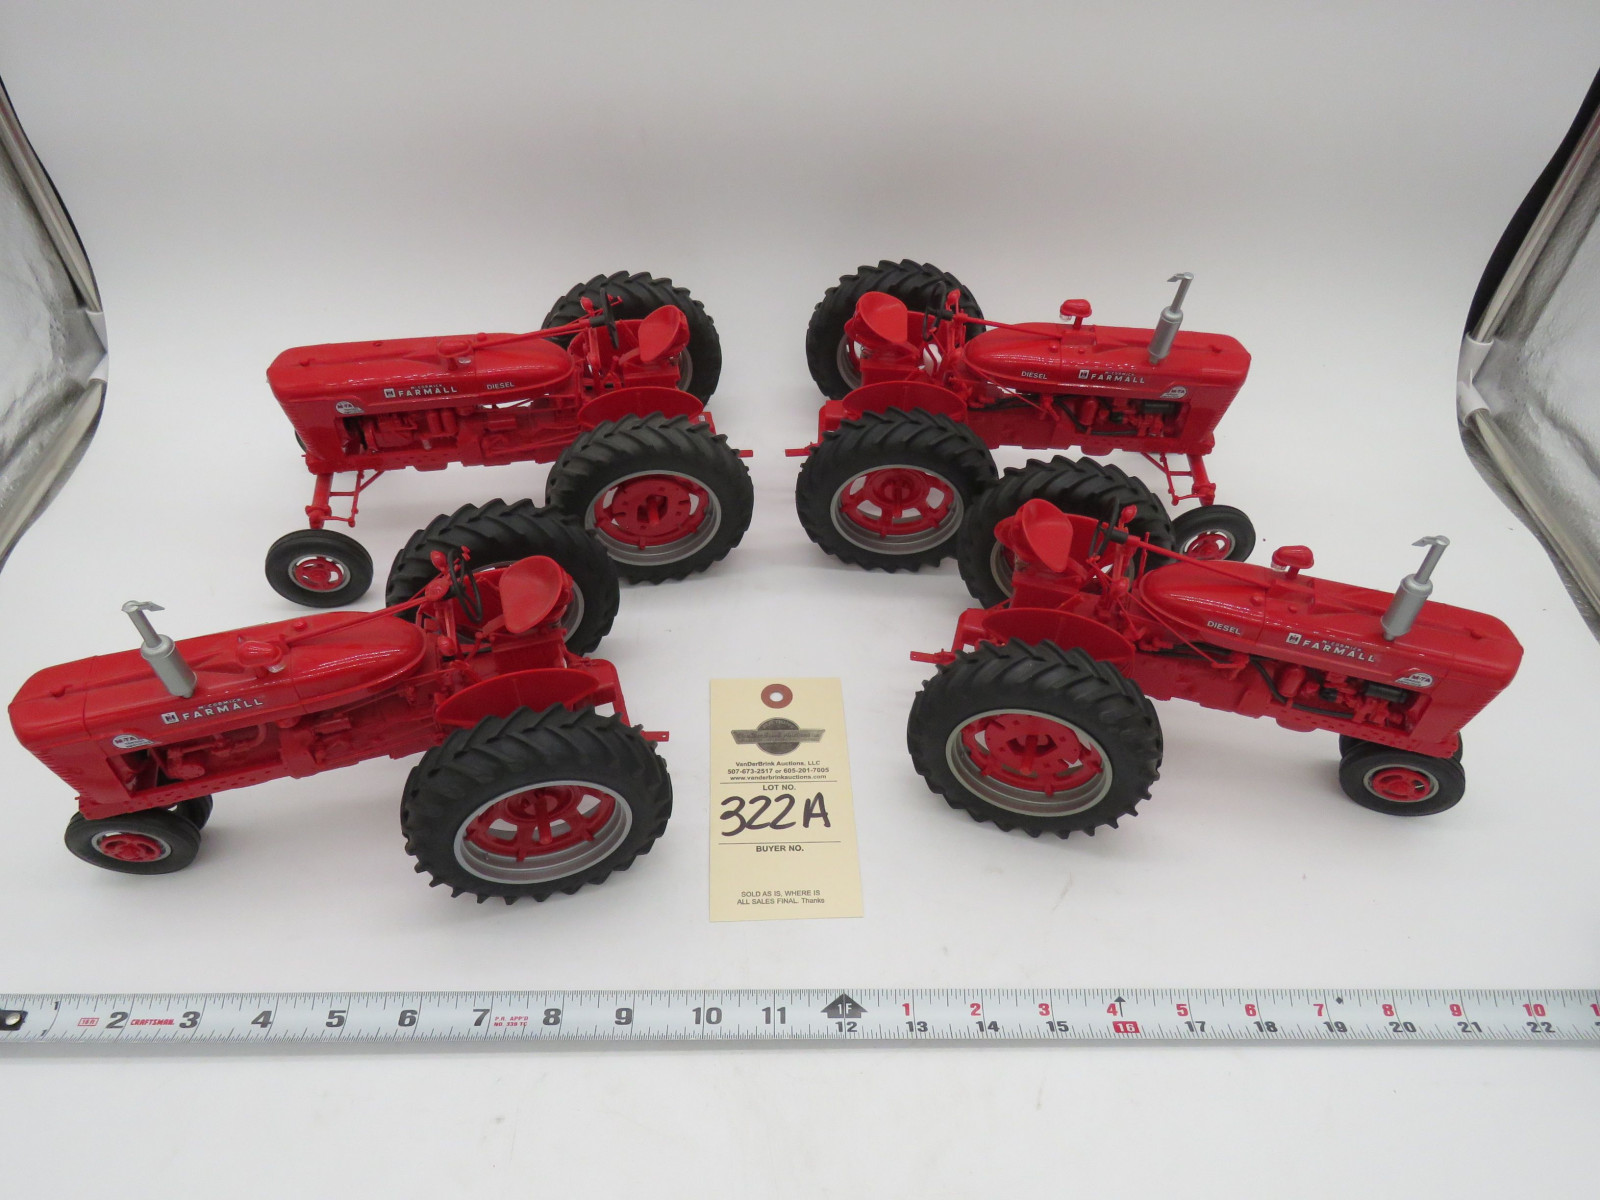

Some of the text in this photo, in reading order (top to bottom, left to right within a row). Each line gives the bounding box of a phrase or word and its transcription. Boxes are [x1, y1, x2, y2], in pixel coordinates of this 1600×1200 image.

[1021, 371, 1047, 380] DIESEL
[1091, 373, 1145, 384] FARMALL
[398, 386, 457, 397] FARMALL
[486, 382, 515, 390] DIESEL
[1207, 620, 1241, 636] DIESEL
[1302, 639, 1375, 662] FARMALL
[182, 698, 263, 720] FARMALL
[719, 791, 831, 837] 322A
[54, 1001, 60, 1010] 1
[837, 1002, 852, 1014] 1F
[902, 1003, 910, 1016] 1
[970, 1003, 981, 1016] 2
[1038, 1003, 1051, 1016] 3
[1106, 1003, 1118, 1015] 4
[1176, 1004, 1189, 1017] 5
[1244, 1004, 1257, 1017] 6
[1313, 1004, 1324, 1017] 7
[1382, 1004, 1394, 1016] 8
[1450, 1004, 1462, 1017] 9
[1522, 1003, 1546, 1017] 10
[105, 1011, 129, 1028] 2
[179, 1011, 200, 1028] 3
[251, 1010, 272, 1028] 4
[325, 1010, 347, 1027] 5
[398, 1009, 418, 1027] 6
[472, 1008, 490, 1026] 7
[542, 1008, 562, 1026] 8
[615, 1007, 633, 1025] 9
[692, 1006, 722, 1025] 10
[762, 1006, 786, 1025] 11
[835, 1021, 858, 1032] 12
[906, 1021, 928, 1032] 13
[975, 1021, 999, 1032] 14
[1046, 1021, 1069, 1032] 15
[1117, 1023, 1136, 1032] 16
[1184, 1021, 1206, 1033] 17
[1253, 1021, 1278, 1033] 18
[1323, 1021, 1348, 1033] 19
[1389, 1021, 1417, 1033] 20
[1457, 1021, 1483, 1033] 21
[1526, 1021, 1556, 1033] 22
